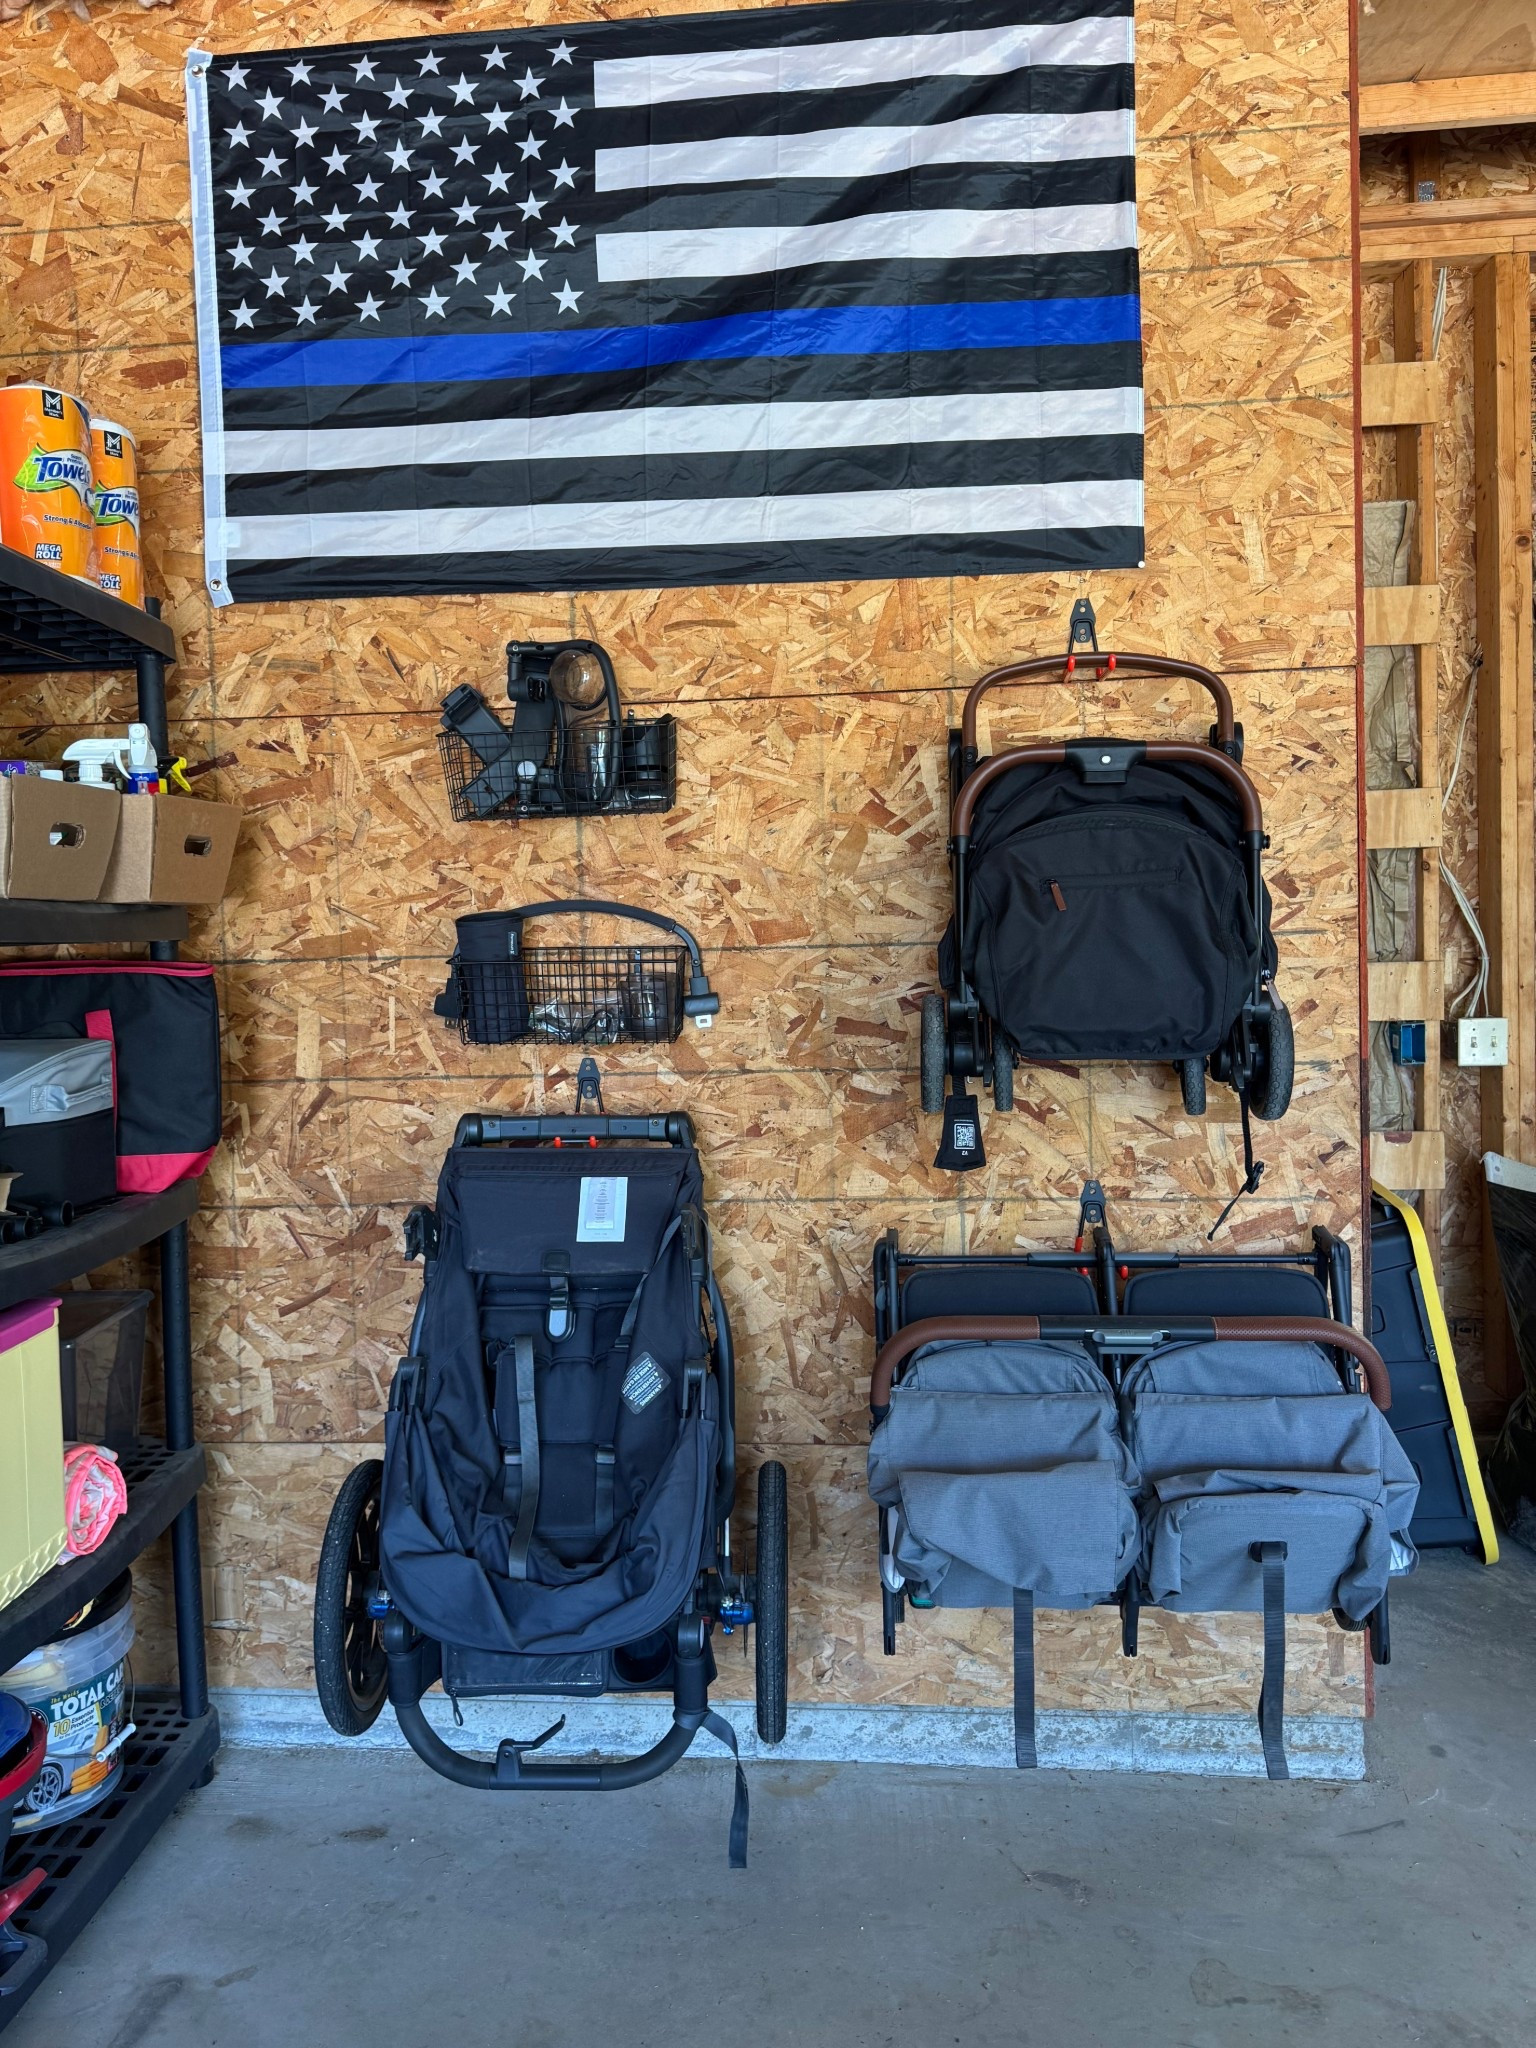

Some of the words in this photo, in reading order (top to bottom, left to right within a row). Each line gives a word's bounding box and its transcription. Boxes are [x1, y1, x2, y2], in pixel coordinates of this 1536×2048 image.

[34, 456, 90, 484] Towels
[43, 514, 68, 525] Strong
[35, 550, 62, 560] ROLL
[36, 543, 62, 552] MEGA
[51, 1682, 104, 1720] TOTAL
[70, 1714, 94, 1730] Products
[71, 1708, 95, 1723] Essential
[53, 1718, 71, 1737] 10
